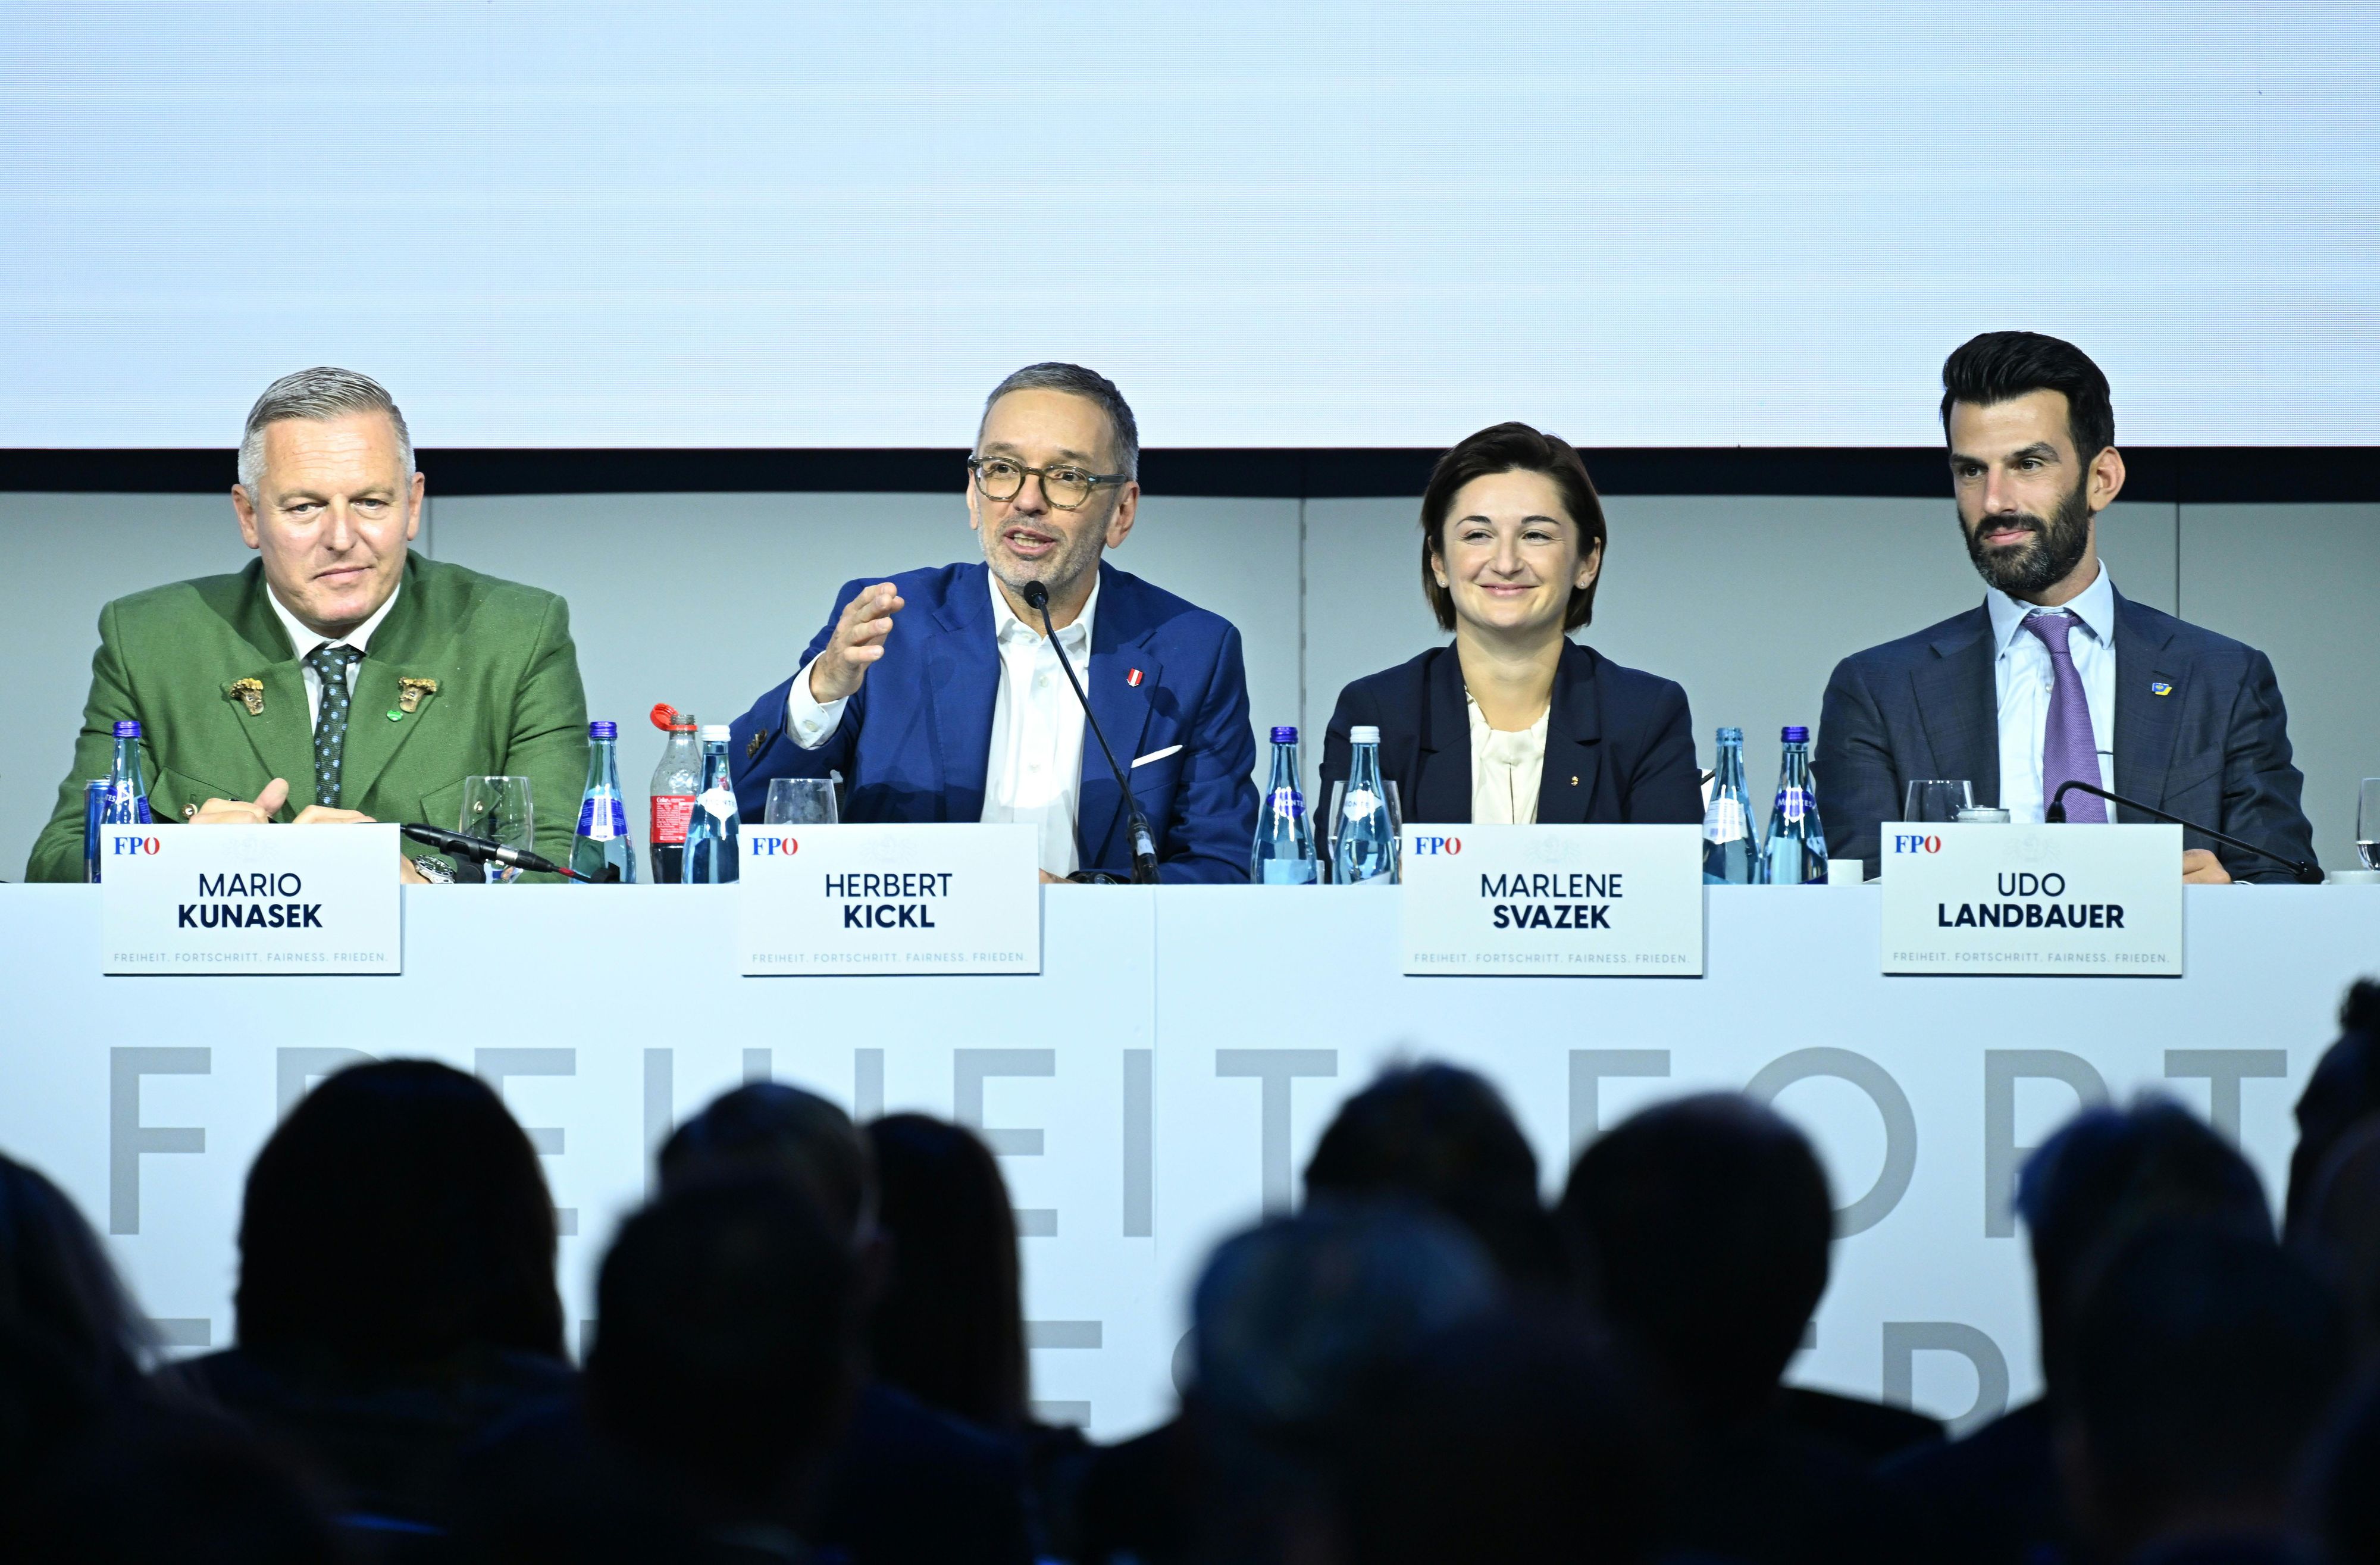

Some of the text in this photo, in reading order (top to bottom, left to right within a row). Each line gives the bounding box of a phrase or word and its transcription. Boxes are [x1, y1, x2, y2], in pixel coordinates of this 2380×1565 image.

[199, 872, 302, 897] MARIO
[825, 873, 953, 898] HERBERT
[1481, 873, 1623, 899] MARLENE
[1997, 872, 2066, 897] UDO
[178, 903, 323, 929] KUNASEK
[844, 904, 935, 929] KICKL
[1493, 904, 1611, 929] SVAZEK
[1938, 903, 2125, 929] LANDBAUER
[114, 953, 388, 962] FREIHEIT. FORTSCHRITT. FAIRNESS. FRIEDEN.
[752, 952, 1028, 963] FREIHEIT. FORTSCHRITT. FAIRNESS. FRIEDEN.
[1414, 953, 1690, 963] FREIHEIT. FORTSCHRITT. FAIRNESS. FRIEDEN.
[1893, 951, 2170, 963] FREIHEIT. FORTSCHRITT. FAIRNESS. FRIEDEN.
